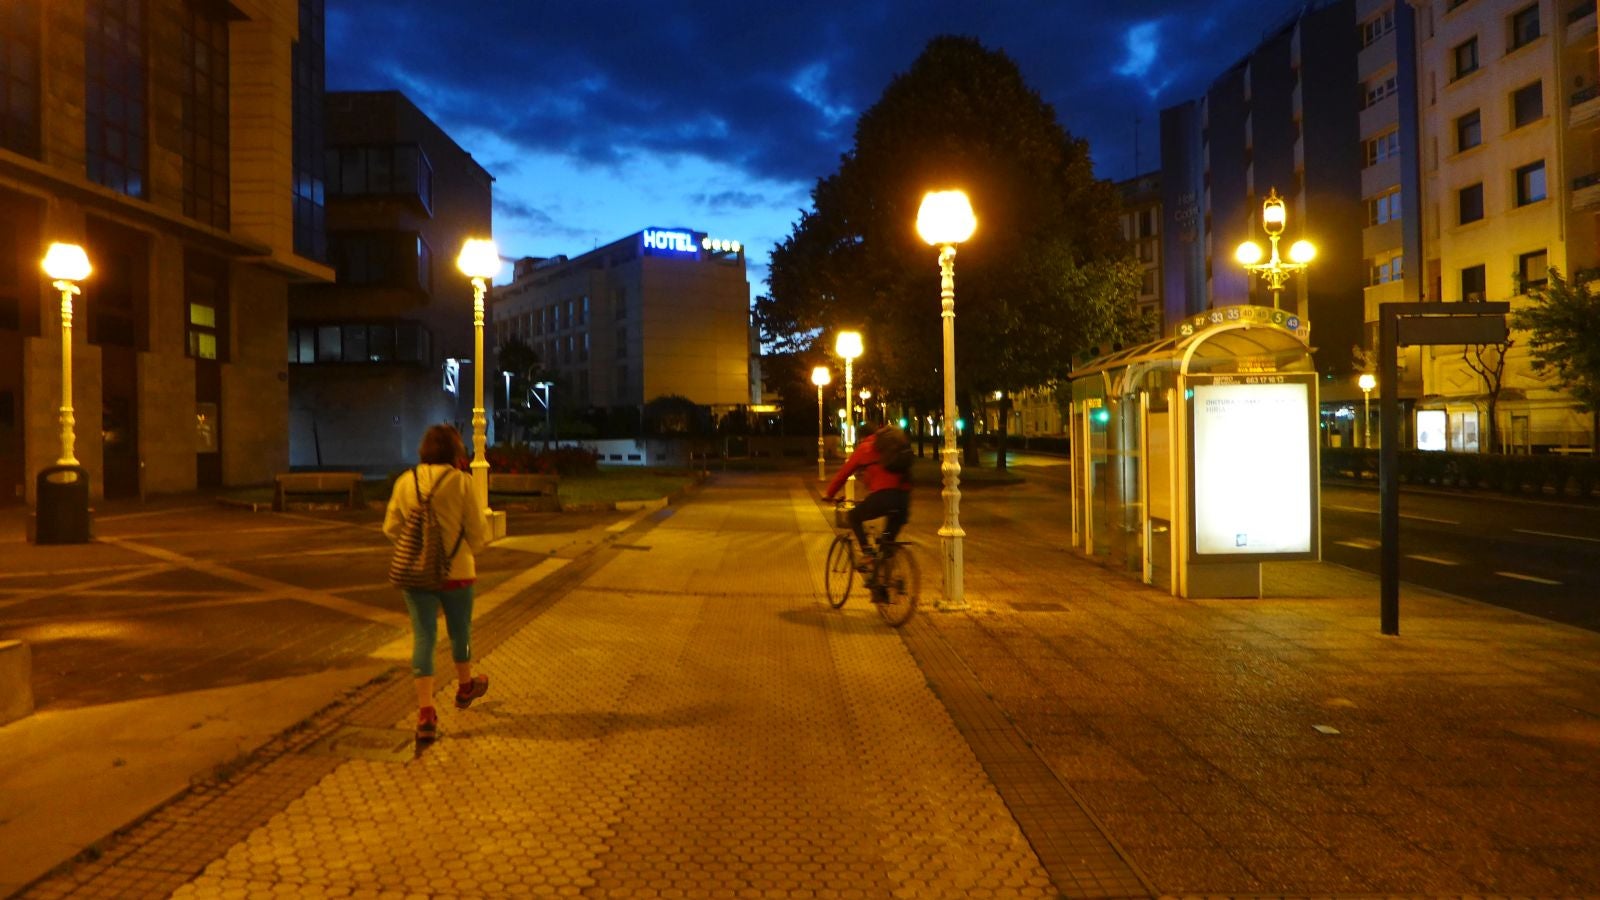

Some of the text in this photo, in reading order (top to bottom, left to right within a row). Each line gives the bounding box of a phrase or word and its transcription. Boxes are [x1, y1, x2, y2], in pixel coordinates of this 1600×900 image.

[643, 229, 698, 252] HOTEL
[1181, 323, 1193, 336] 25
[1211, 312, 1224, 323] 33
[1227, 309, 1240, 320] 35
[1275, 312, 1282, 323] 5
[1287, 316, 1299, 327] 43
